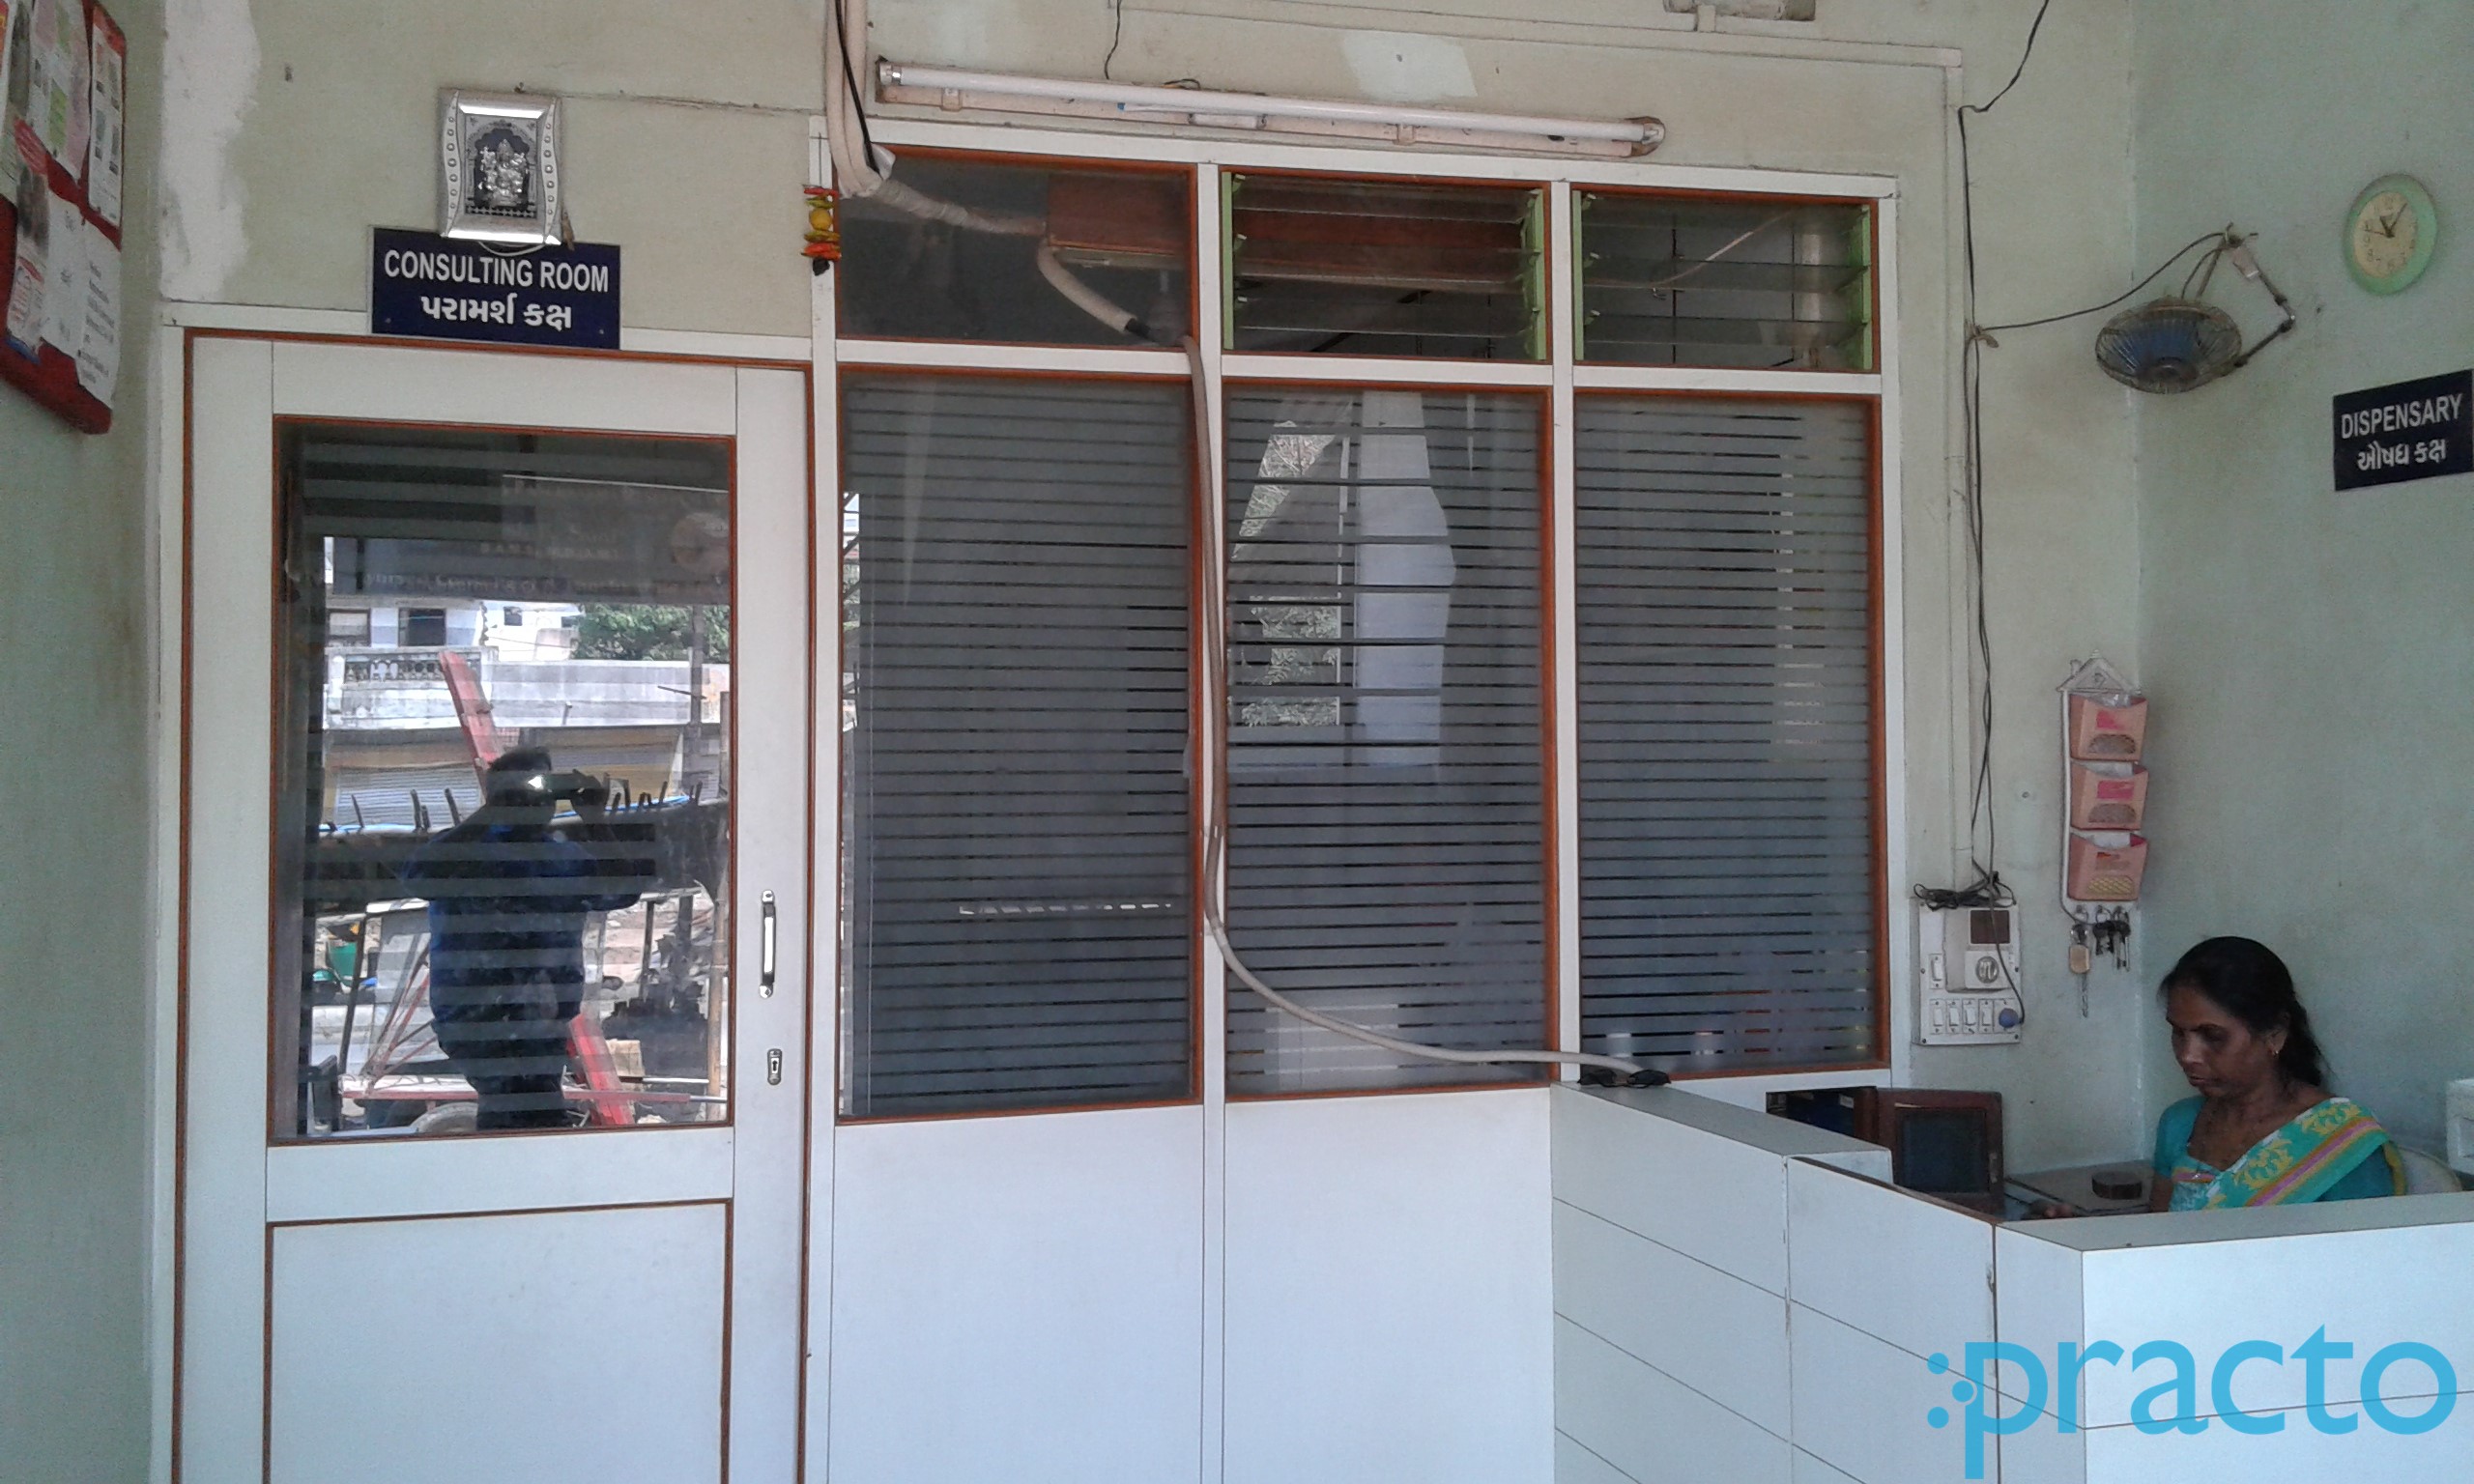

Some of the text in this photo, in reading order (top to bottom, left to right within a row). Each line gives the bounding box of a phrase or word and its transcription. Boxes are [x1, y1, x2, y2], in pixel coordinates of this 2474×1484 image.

[384, 249, 608, 293] CONSULTING ROOM
[420, 292, 572, 331] પરામર્શ કક્ષ
[2341, 392, 2463, 440] DISPENSARY
[2413, 439, 2448, 464] કક્ષ
